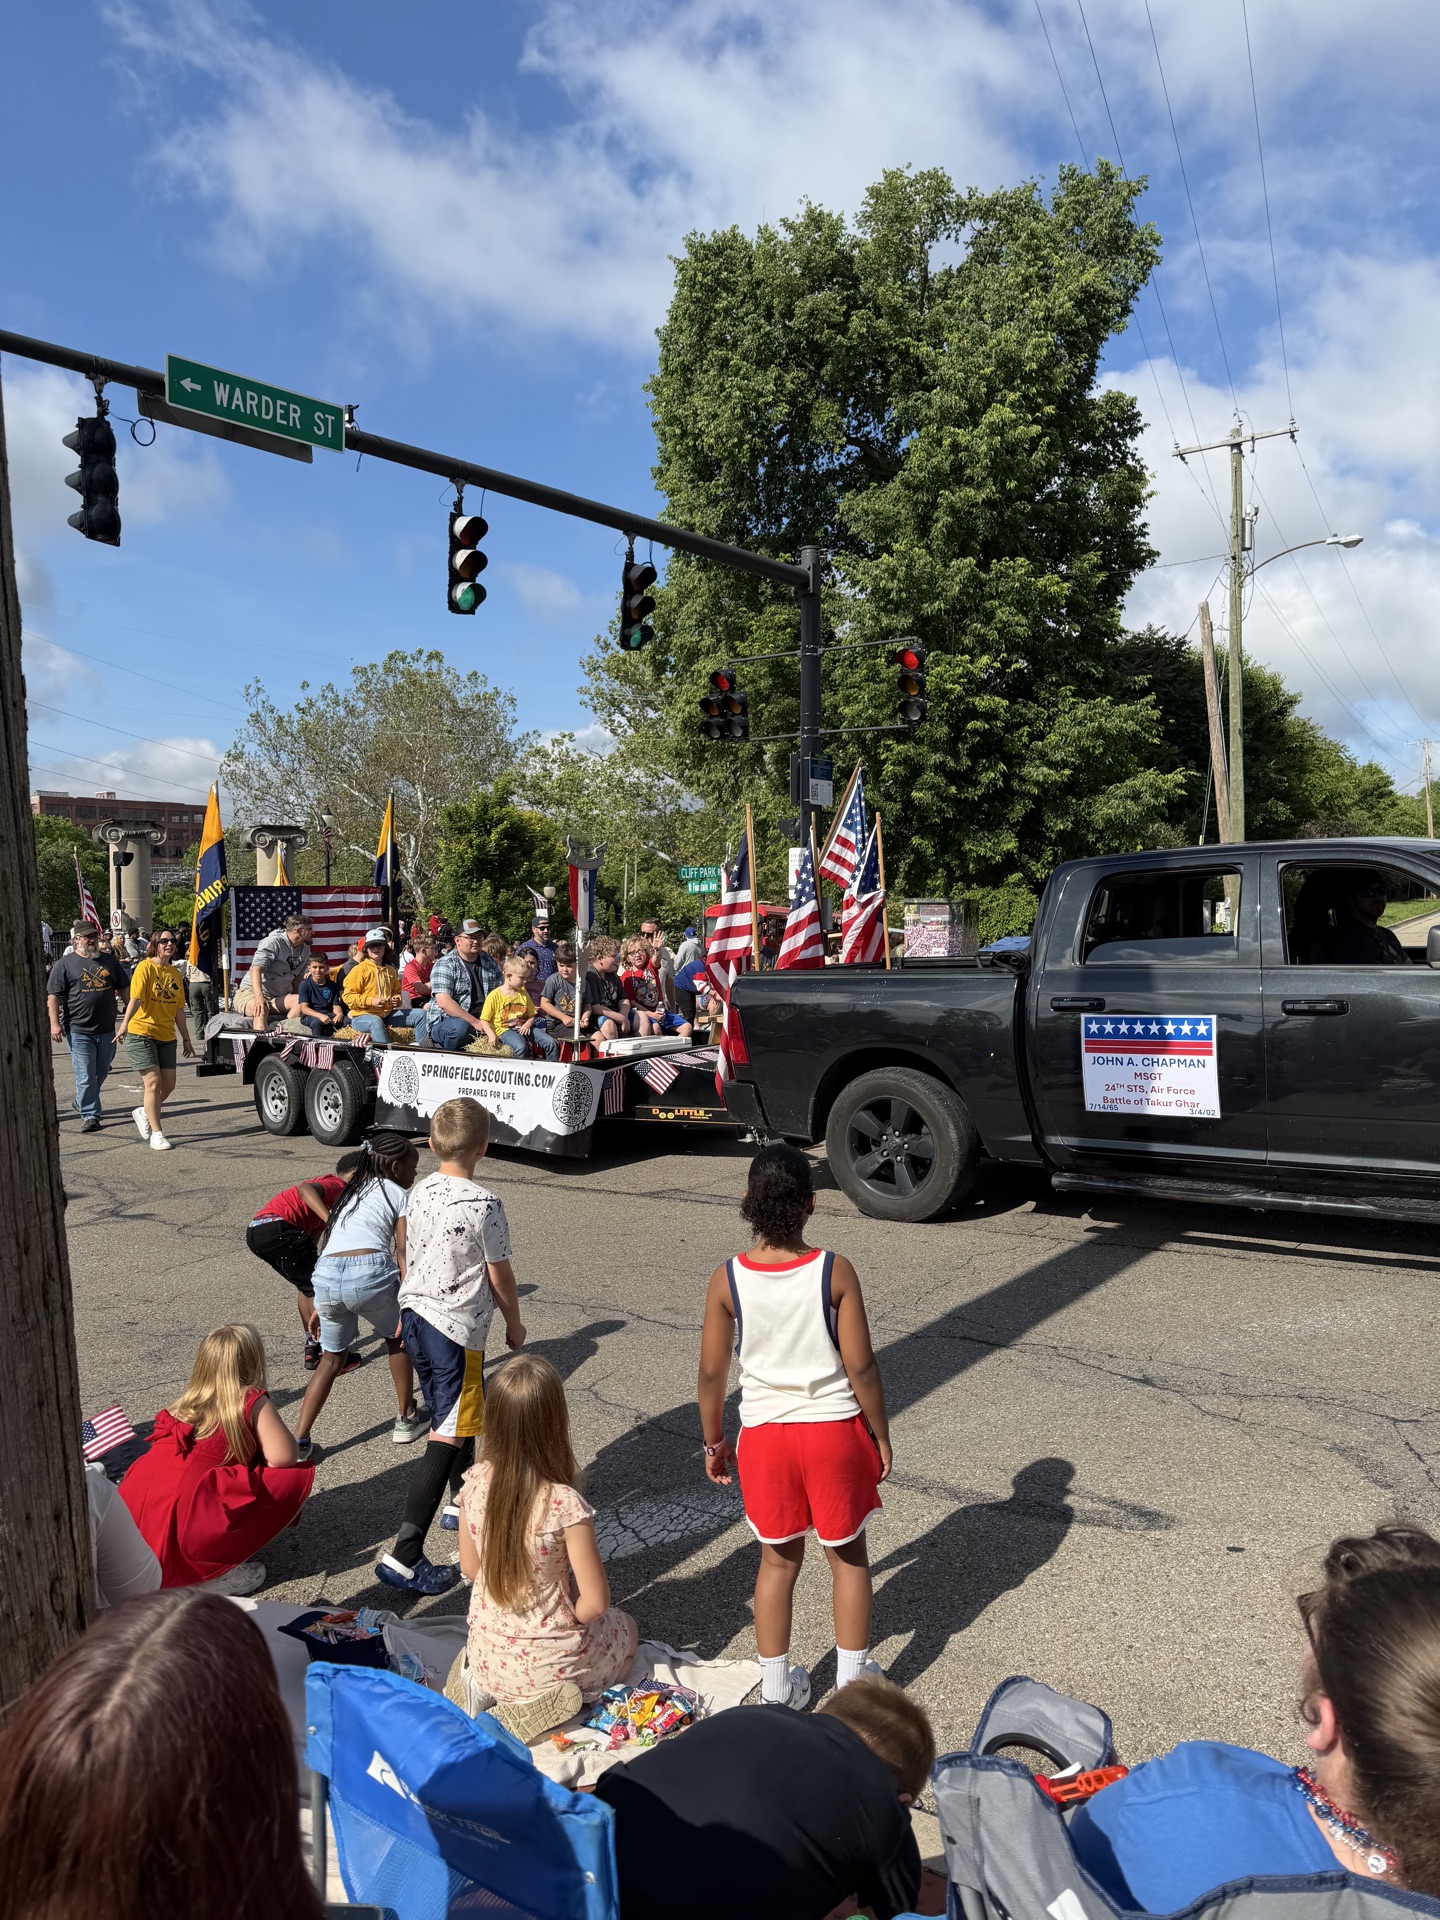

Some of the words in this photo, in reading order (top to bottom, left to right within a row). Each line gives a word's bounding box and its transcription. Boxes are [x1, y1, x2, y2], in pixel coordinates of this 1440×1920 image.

[213, 380, 301, 429] WARDER
[313, 411, 335, 438] ST
[681, 868, 698, 879] CLIFF
[700, 867, 717, 878] PARK
[1091, 1056, 1124, 1067] JOHN
[1126, 1058, 1139, 1067] A.
[1141, 1057, 1206, 1068] CHAPMAN
[421, 1063, 556, 1089] SPRINGFIELDSCOUTING.COM
[1134, 1072, 1164, 1081] MSGT
[458, 1087, 487, 1098] PREPARED
[490, 1090, 501, 1099] FOR
[503, 1092, 516, 1101] LIFE
[1104, 1083, 1125, 1092] 24TH
[1127, 1084, 1148, 1095] STS,
[1150, 1086, 1165, 1095] Air
[1167, 1086, 1196, 1096] Force
[1089, 1103, 1119, 1111] 7/14/65
[1103, 1096, 1131, 1106] Battle
[1134, 1096, 1144, 1106] of
[1146, 1098, 1173, 1108] Takur
[1175, 1100, 1200, 1109] Ghar
[1189, 1108, 1217, 1116] 3/4/02
